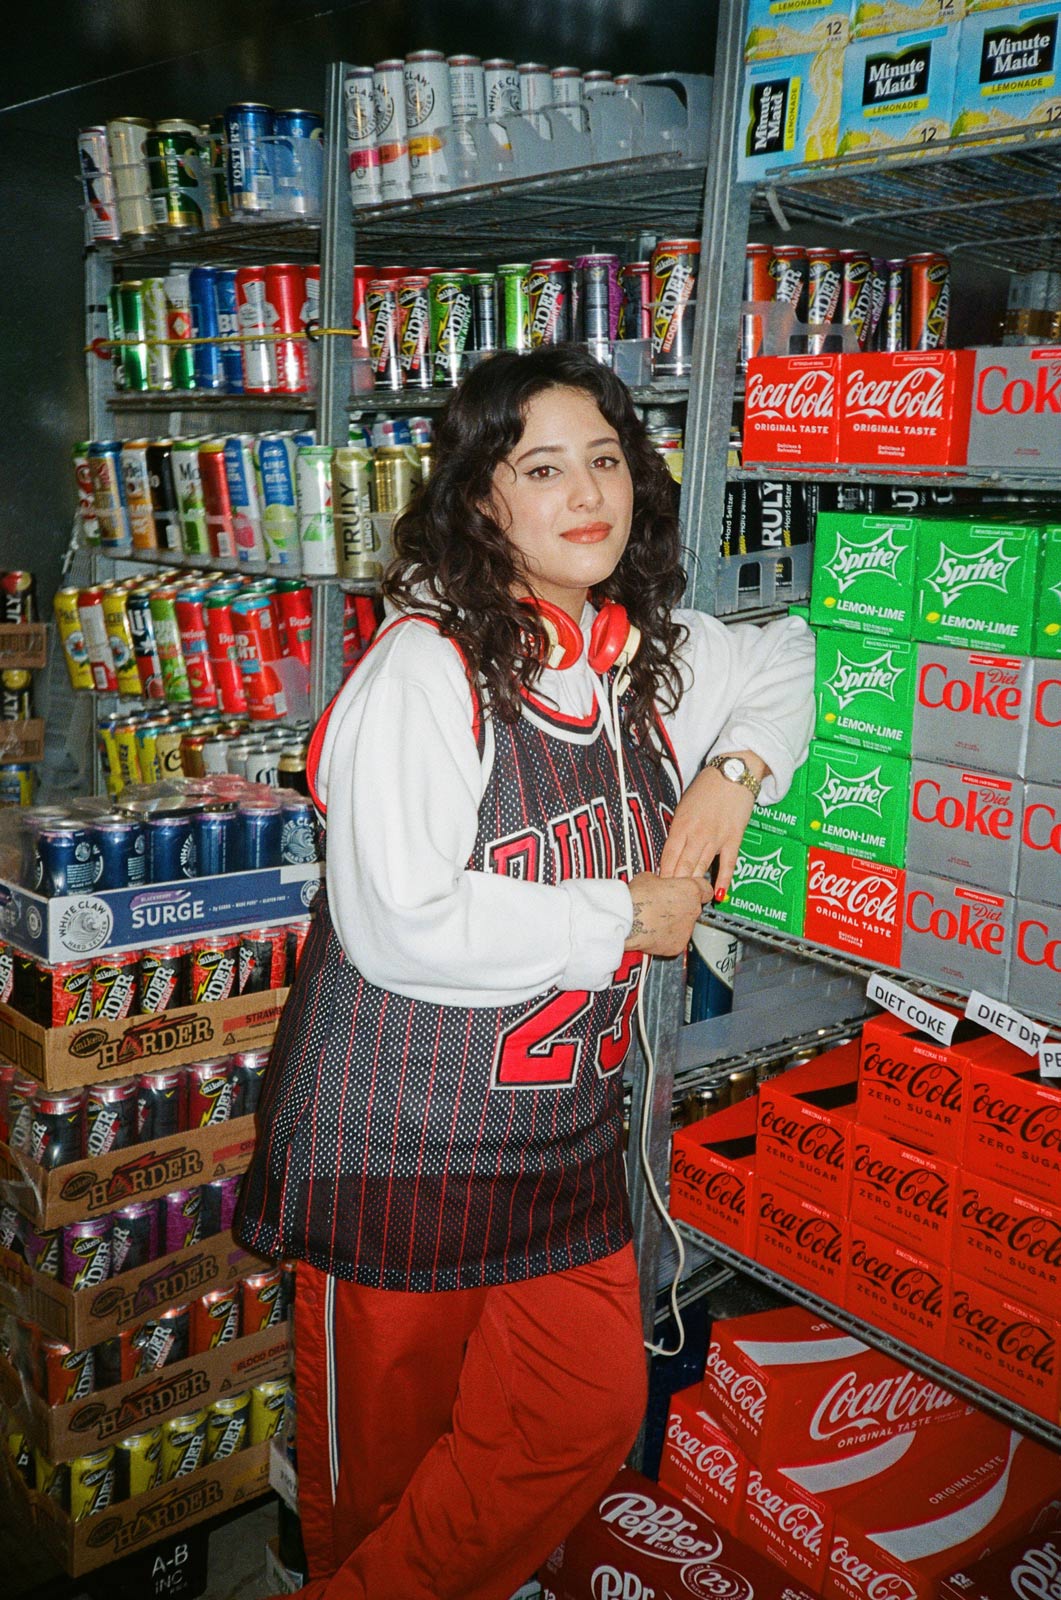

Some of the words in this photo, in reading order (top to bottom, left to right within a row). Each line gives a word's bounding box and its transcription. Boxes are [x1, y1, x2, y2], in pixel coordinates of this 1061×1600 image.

[826, 21, 842, 36] 12
[987, 33, 1051, 58] Minute
[869, 58, 925, 82] Minute
[993, 50, 1041, 74] Maid
[875, 78, 918, 98] Maid
[991, 77, 1043, 93] LEMONADE
[755, 86, 773, 151] Minute
[767, 91, 784, 139] Maid
[787, 87, 799, 140] LEMONADE
[872, 100, 920, 114] LEMONADE
[920, 127, 937, 143] 12
[653, 264, 693, 353] HARDER
[976, 365, 1061, 416] Cok
[754, 423, 797, 434] ORIGINAL
[799, 424, 830, 435] TASTE
[852, 423, 901, 435] ORIGINAL
[903, 425, 938, 436] TASTE
[761, 481, 784, 547] RULY
[784, 483, 792, 509] Seltzer
[339, 482, 361, 561] TRULY
[784, 508, 793, 532] Hard
[833, 545, 895, 573] Sprite
[935, 556, 1005, 587] Sprite
[836, 599, 906, 621] LEMON-LIME
[941, 614, 1020, 637] LEMON-LIME
[833, 664, 893, 692] Sprite
[917, 662, 1023, 721] Coke
[987, 668, 1019, 686] Diet
[836, 715, 905, 741] LEMON-LIME
[821, 778, 879, 804] Sprite
[979, 788, 1011, 806] Diet
[751, 805, 798, 826] MON-LIME
[911, 778, 1015, 841] Coke
[822, 822, 886, 848] LEMON-LIME
[733, 855, 781, 882] Sprite
[58, 905, 77, 938] WHITE
[78, 900, 107, 914] CLAW
[131, 900, 205, 929] SURGE
[730, 896, 788, 922] LEMON-LIME
[815, 905, 860, 928] ORIGINAL
[861, 920, 892, 938] TASTE
[905, 889, 1006, 955] Coke
[972, 902, 1003, 921] Diet
[490, 950, 643, 1092] 23
[874, 985, 906, 1012] DIET
[906, 1005, 947, 1037] COKE
[977, 1004, 1018, 1033] DIET
[1018, 1025, 1042, 1048] DR
[98, 1016, 214, 1070] HARDER
[867, 1088, 902, 1107] ZERO
[906, 1102, 953, 1126] SUGAR
[765, 1145, 795, 1164] ZERO
[799, 1160, 838, 1184] SUGAR
[977, 1133, 1015, 1154] ZERO
[1027, 1150, 1061, 1172] SUGA
[88, 1149, 204, 1211] HARDER
[677, 1187, 703, 1206] ZERO
[706, 1201, 740, 1226] SUGAR
[858, 1188, 891, 1209] ZERO
[895, 1205, 940, 1232] SUGAR
[763, 1233, 792, 1255] ZERO
[797, 1249, 835, 1277] SUGAR
[967, 1236, 1003, 1260] ZERO
[1008, 1256, 1058, 1284] SUGAR
[856, 1283, 888, 1305] ZERO
[892, 1301, 935, 1329] SUGAR
[150, 1326, 173, 1367] DER
[957, 1337, 993, 1361] ZERO
[997, 1358, 1046, 1388] SUGAR
[98, 1370, 210, 1441] HARDER
[708, 1382, 738, 1417] ORIGINAL
[737, 1413, 760, 1438] TASTE
[837, 1427, 894, 1449] ORIGINAL
[897, 1416, 932, 1432] TASTE
[669, 1454, 704, 1487] ORIGINAL
[703, 1482, 729, 1506] TASTE
[928, 1474, 976, 1505] ORIGINAL
[972, 1455, 1005, 1478] TASTE
[600, 1495, 713, 1558] Pepper
[646, 1504, 699, 1533] Dr
[749, 1513, 786, 1548] ORIGINAL
[785, 1544, 814, 1570] TASTE
[152, 1543, 189, 1577] A-B
[699, 1571, 732, 1594] 23
